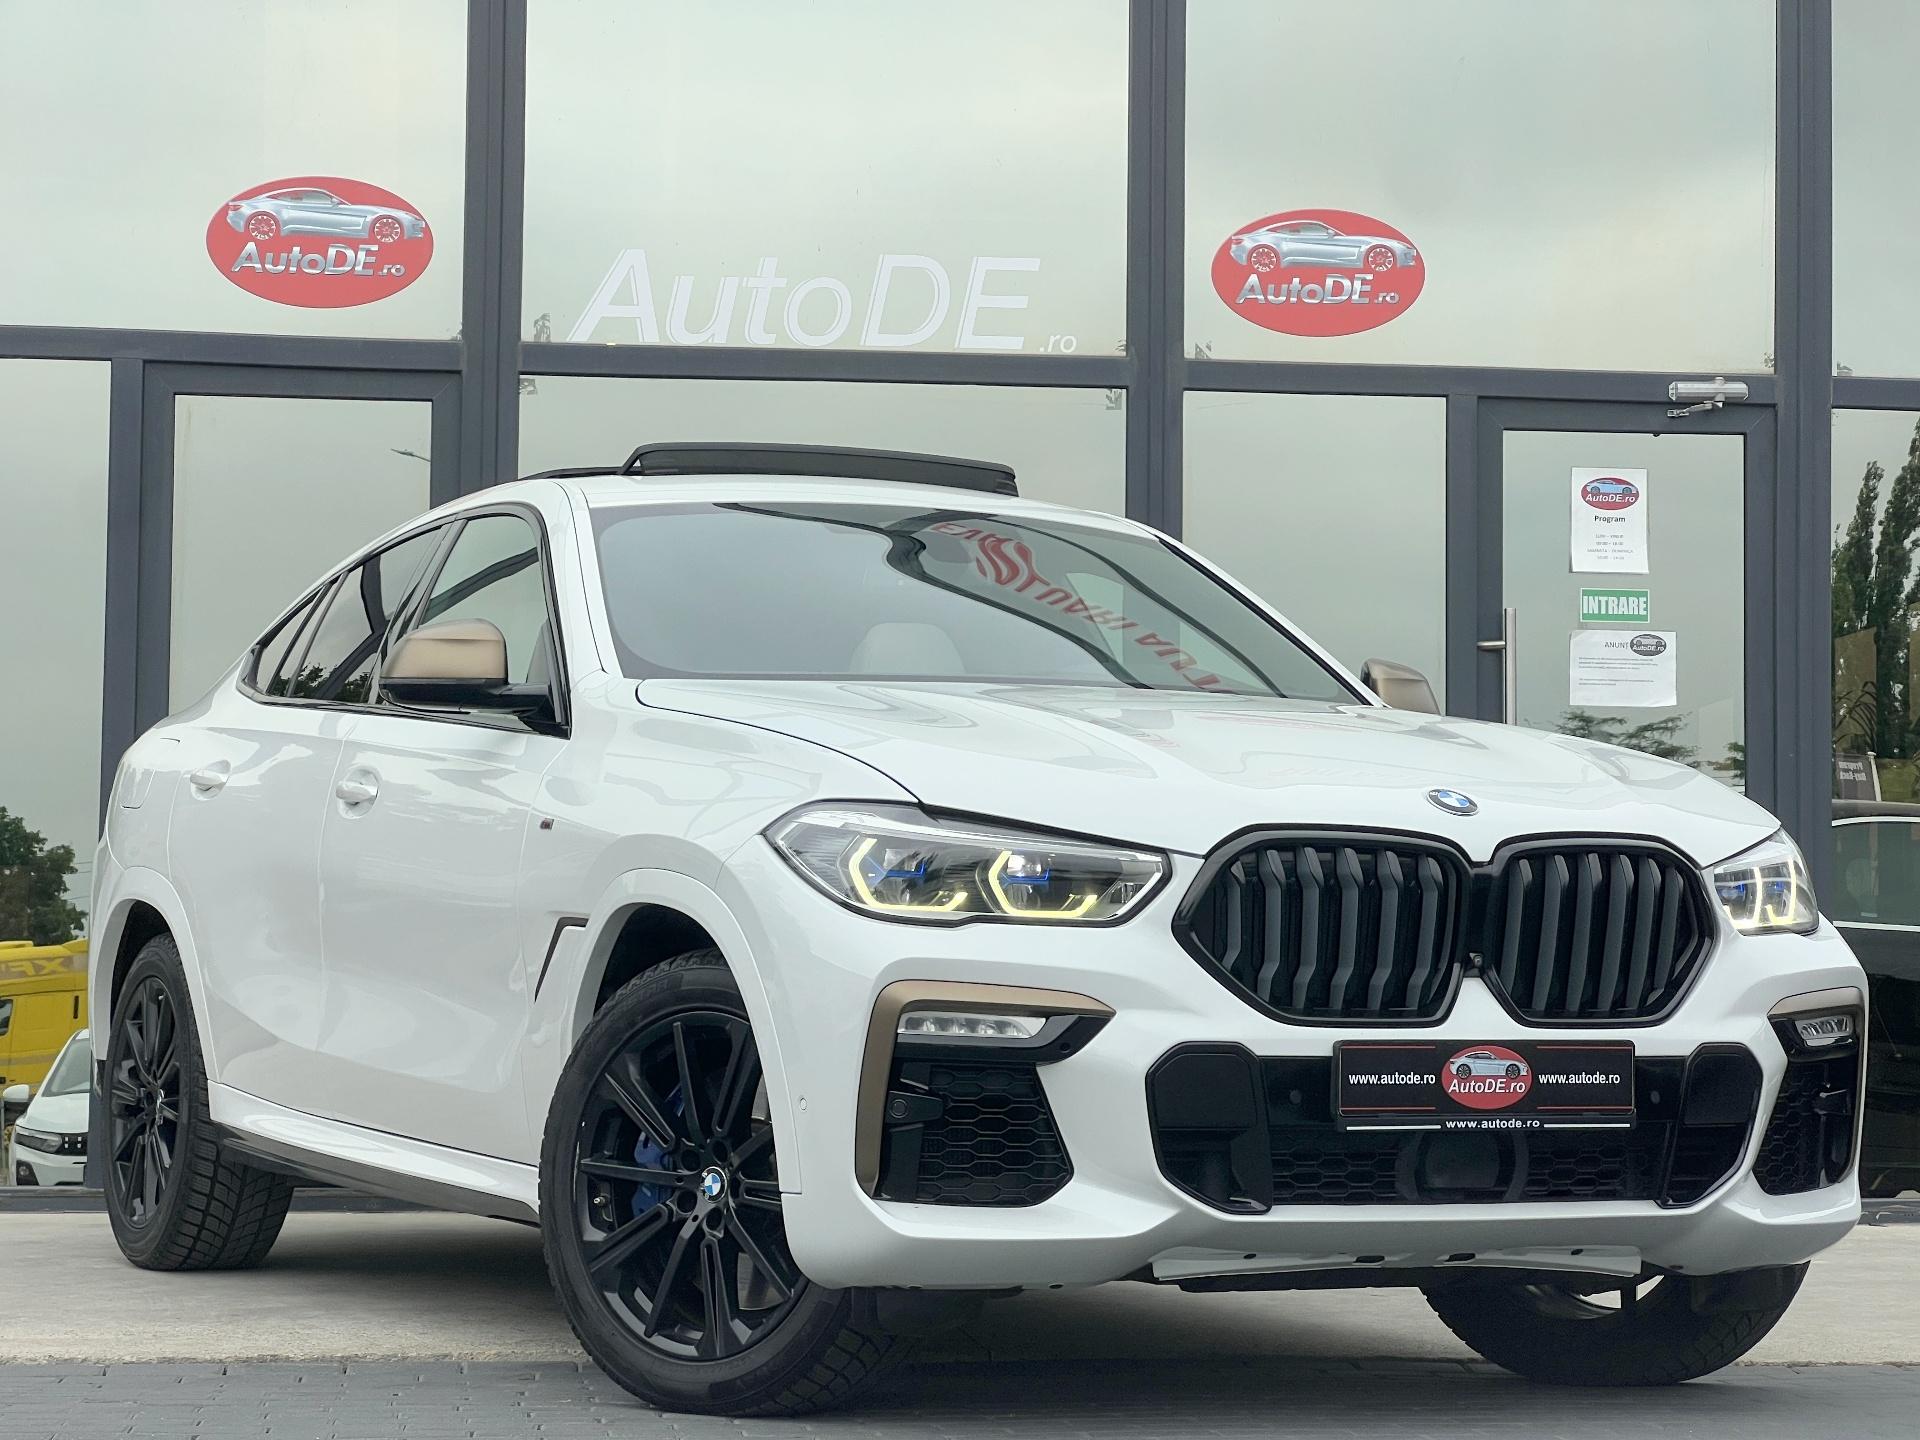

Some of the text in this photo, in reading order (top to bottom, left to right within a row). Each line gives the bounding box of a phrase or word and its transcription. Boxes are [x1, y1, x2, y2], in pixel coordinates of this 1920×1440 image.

[1585, 493, 1636, 503] AutoDE.ro
[1594, 515, 1626, 524] Program
[1582, 595, 1648, 616] INTRARE
[1348, 1071, 1621, 1094] www.autode.ro AutoDE.ro www.autode.ro
[1445, 1118, 1540, 1130] www.autode.ro
